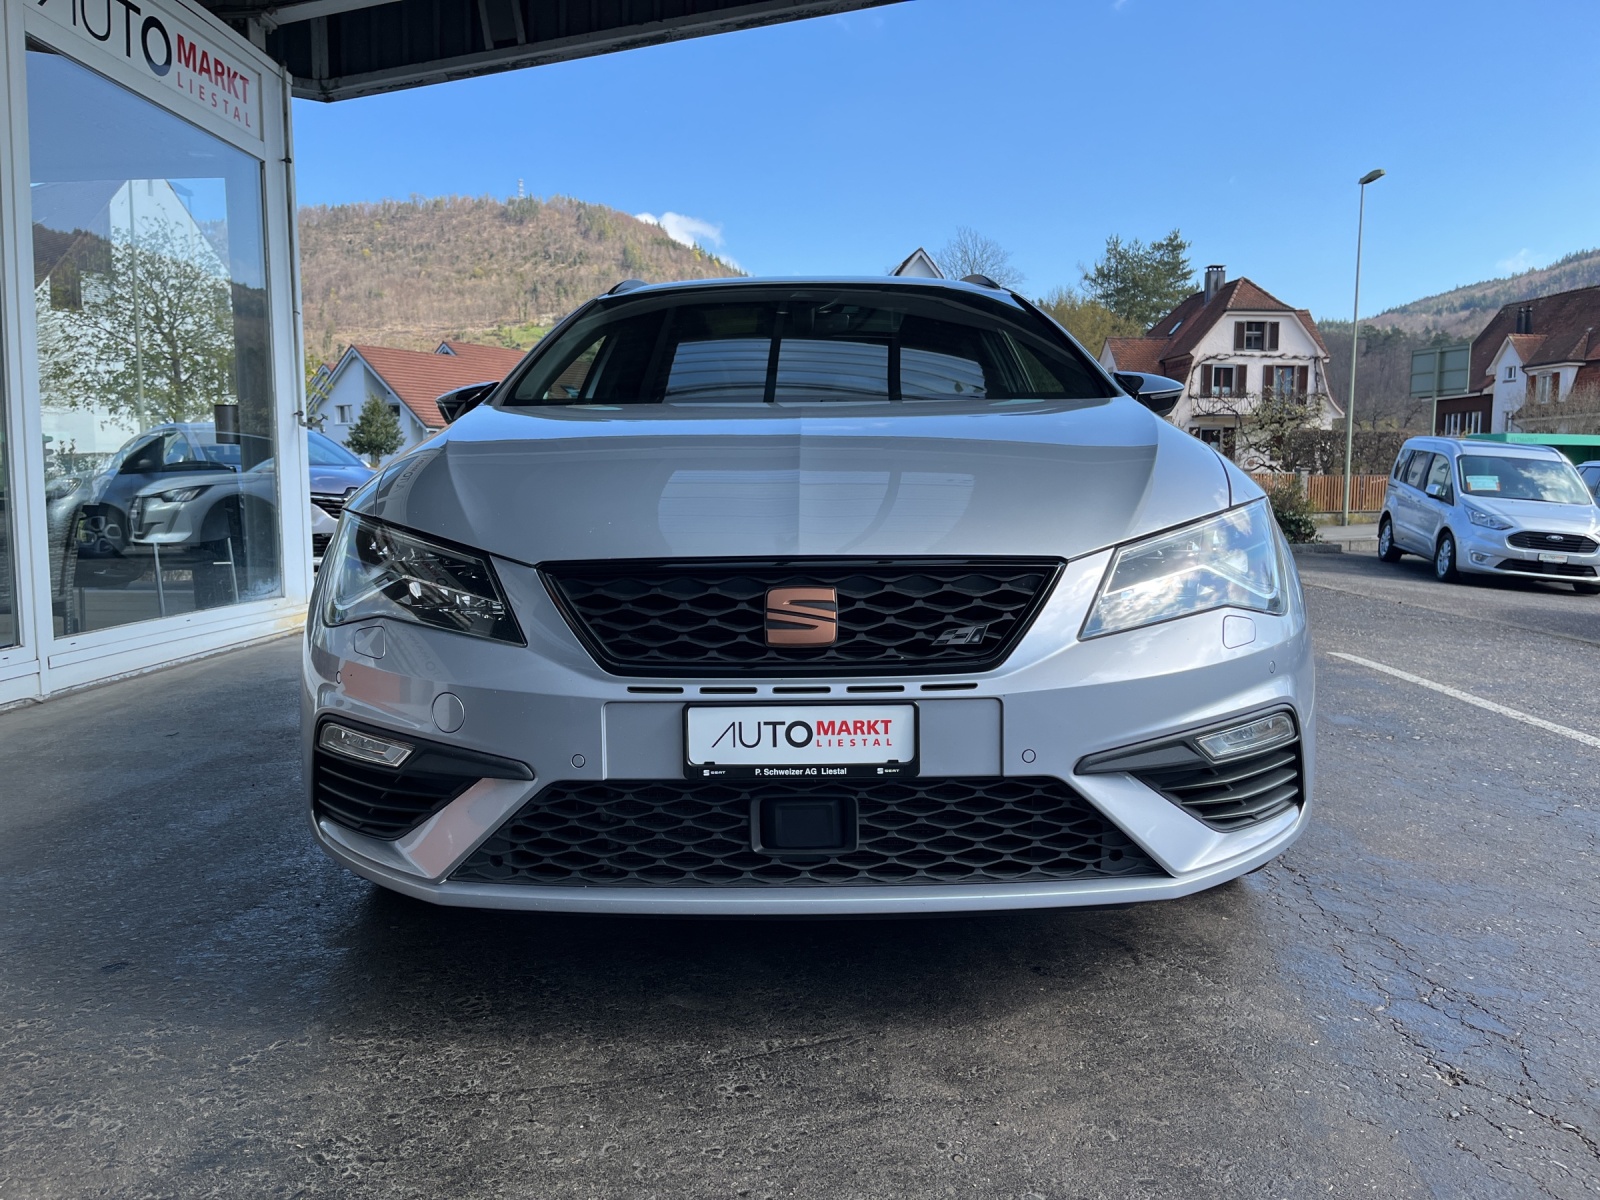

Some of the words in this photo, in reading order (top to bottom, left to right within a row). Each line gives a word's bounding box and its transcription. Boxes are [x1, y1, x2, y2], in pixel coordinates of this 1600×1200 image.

[177, 33, 249, 104] MARKT
[177, 71, 251, 128] LIESTAL
[711, 720, 814, 749] AUTO
[816, 719, 892, 736] MARKT
[816, 738, 892, 748] LIESTAL
[755, 768, 762, 776] P.
[763, 768, 803, 776] Schweizer
[805, 767, 817, 775] AG
[821, 767, 847, 775] Liestal
